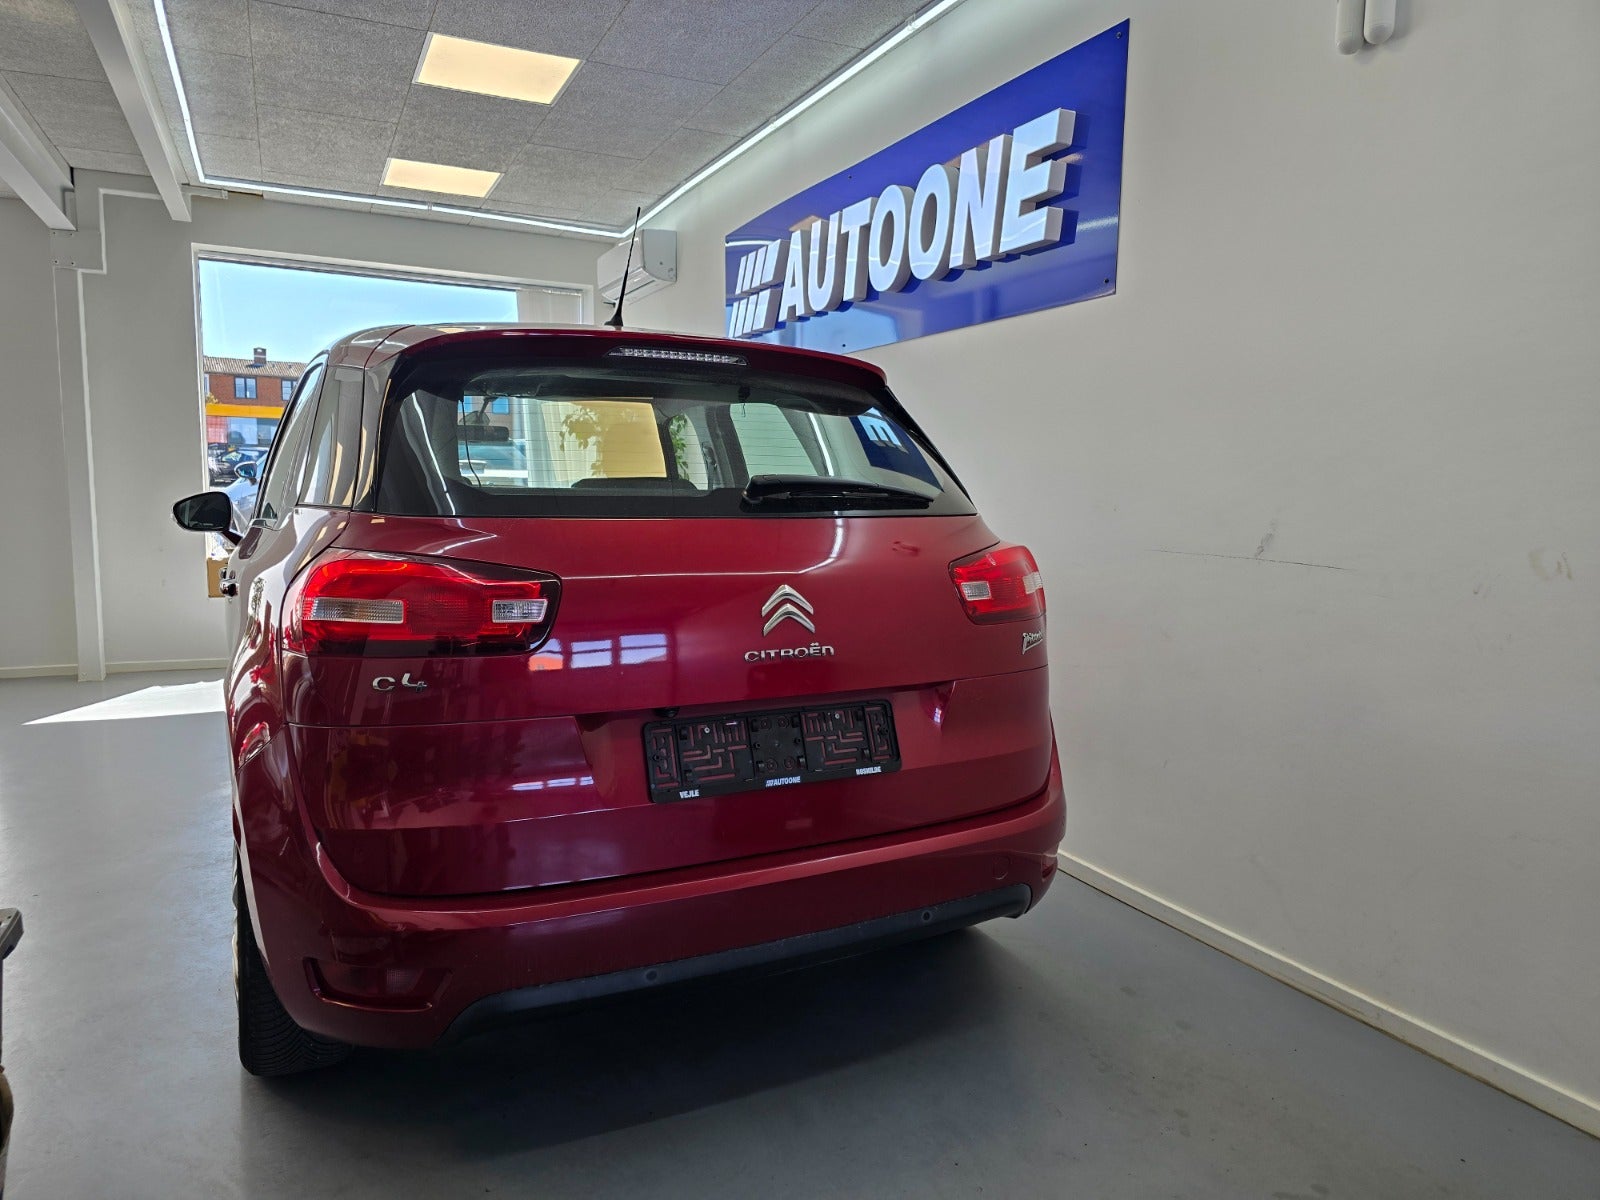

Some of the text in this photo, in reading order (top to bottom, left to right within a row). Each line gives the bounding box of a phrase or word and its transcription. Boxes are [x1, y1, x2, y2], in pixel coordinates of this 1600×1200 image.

[779, 107, 1077, 323] AUTOONE
[773, 775, 801, 787] AUTOONE
[679, 789, 700, 799] VEJLE
